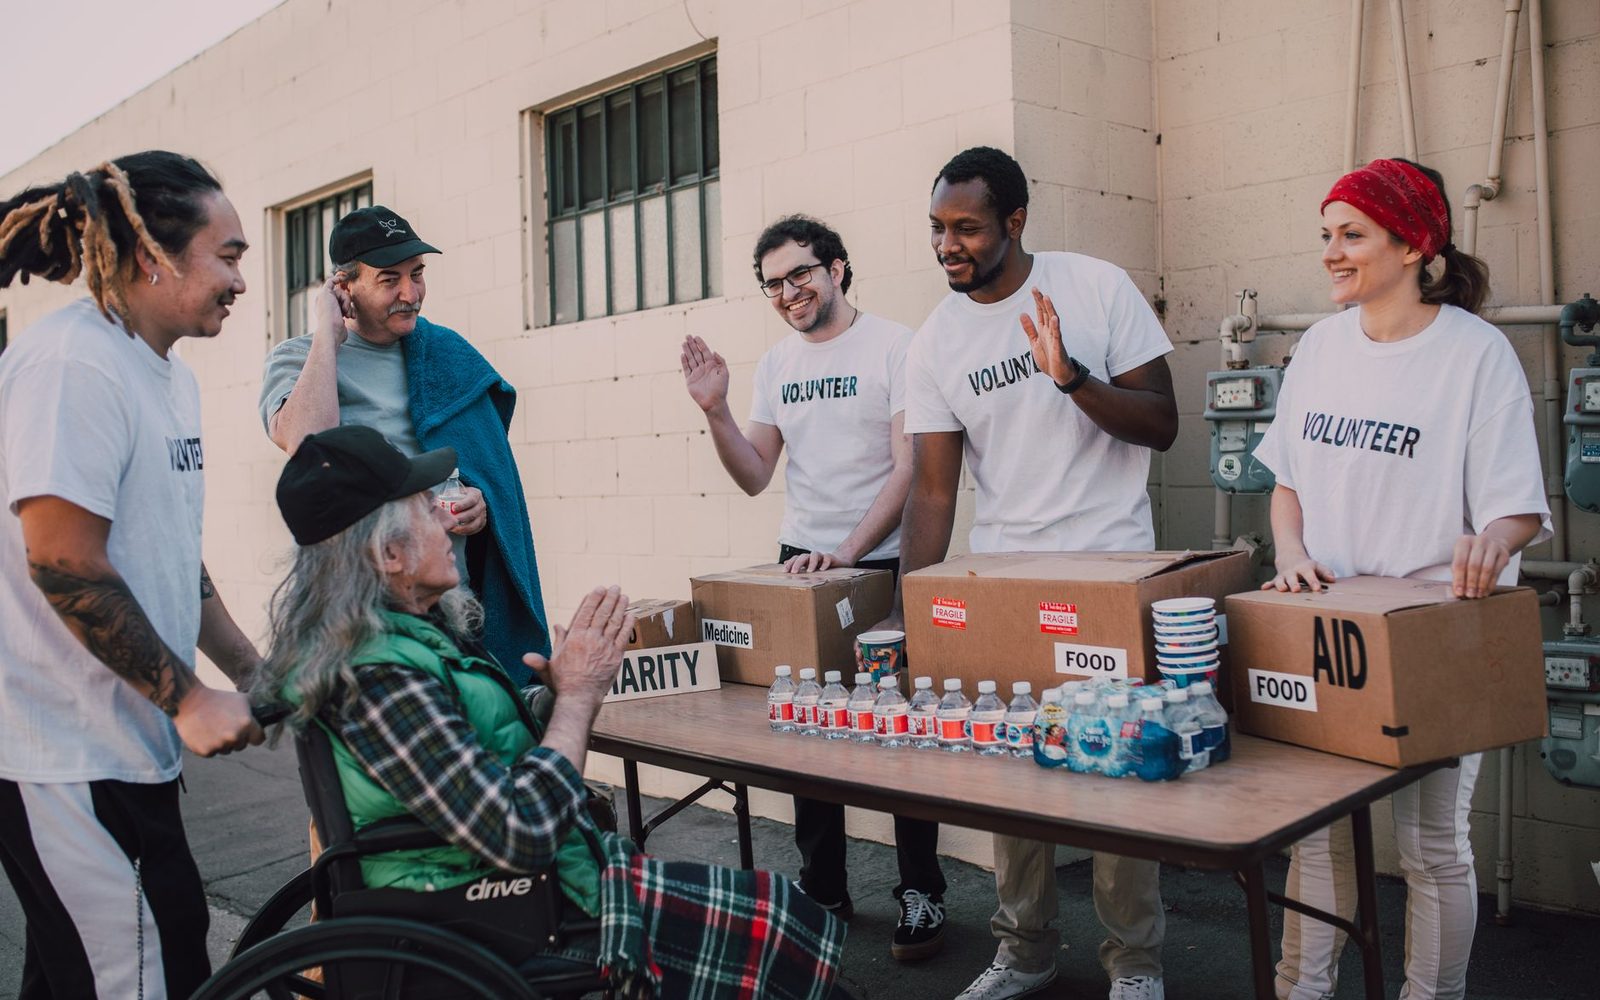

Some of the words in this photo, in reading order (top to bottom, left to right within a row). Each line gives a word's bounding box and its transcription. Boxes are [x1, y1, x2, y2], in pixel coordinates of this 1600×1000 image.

[782, 375, 858, 404] VOLUNTEER
[1302, 411, 1421, 459] VOLUNTEER
[935, 607, 964, 620] FRAGILE
[1042, 613, 1075, 625] FRAGILE
[704, 621, 750, 646] Medicine
[1066, 650, 1116, 672] FOOD
[1313, 615, 1368, 690] AID
[612, 649, 699, 695] ARITY
[1256, 675, 1307, 703] FOOD
[465, 878, 533, 902] drive
